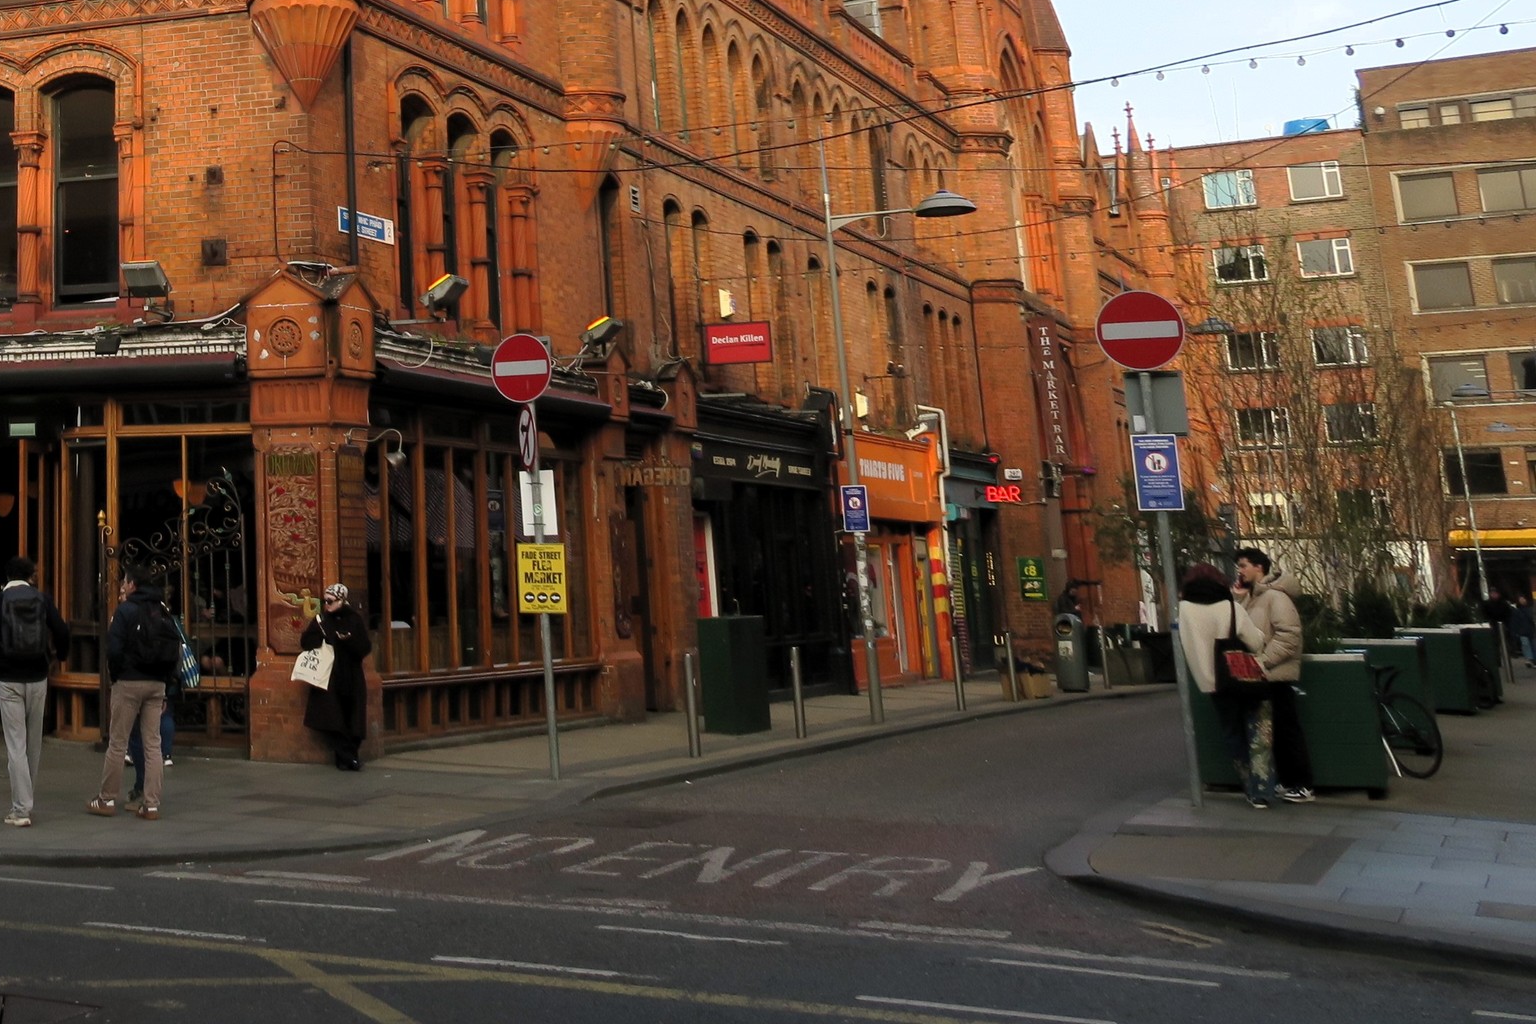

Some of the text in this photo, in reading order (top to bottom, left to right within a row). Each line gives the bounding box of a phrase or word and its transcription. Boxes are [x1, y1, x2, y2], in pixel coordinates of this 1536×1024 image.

[711, 334, 764, 345] Declan Killen
[1039, 327, 1065, 454] THE MARKET BAR
[859, 458, 905, 482] THIRTY FIVE
[986, 486, 1021, 502] BAR
[521, 551, 561, 560] FADE STREET
[532, 560, 552, 571] FLEA
[524, 572, 562, 584] MARKET
[366, 829, 1043, 902] NO ENTRY
